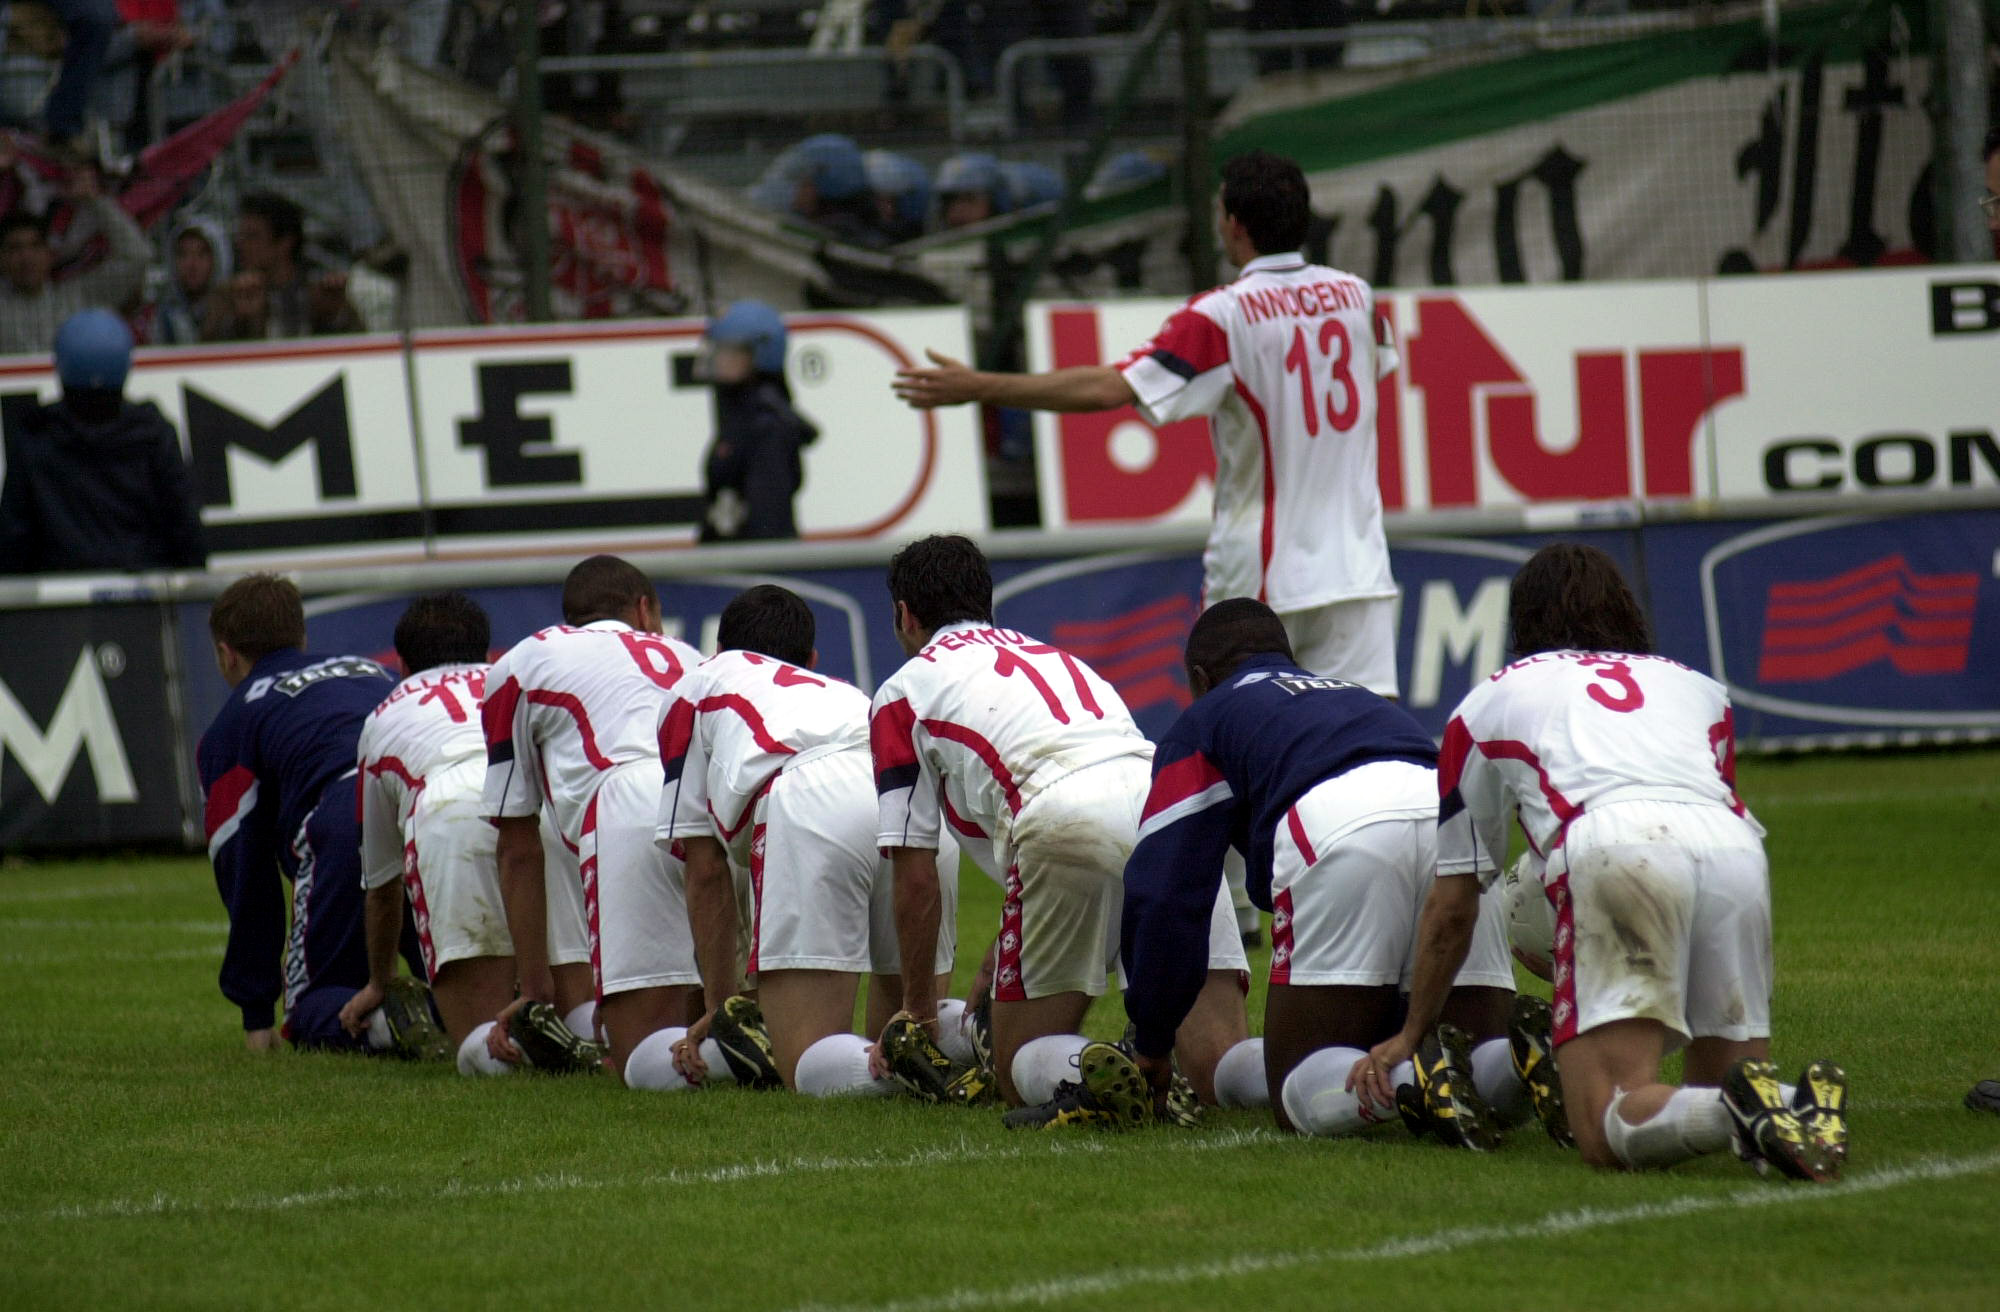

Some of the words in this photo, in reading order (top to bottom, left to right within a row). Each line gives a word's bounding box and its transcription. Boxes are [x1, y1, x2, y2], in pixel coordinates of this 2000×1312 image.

[1238, 279, 1366, 325] INNOCENTI
[1286, 318, 1360, 438] 13
[617, 631, 684, 690] 6
[993, 644, 1105, 725] 17
[1577, 655, 1645, 713] 3
